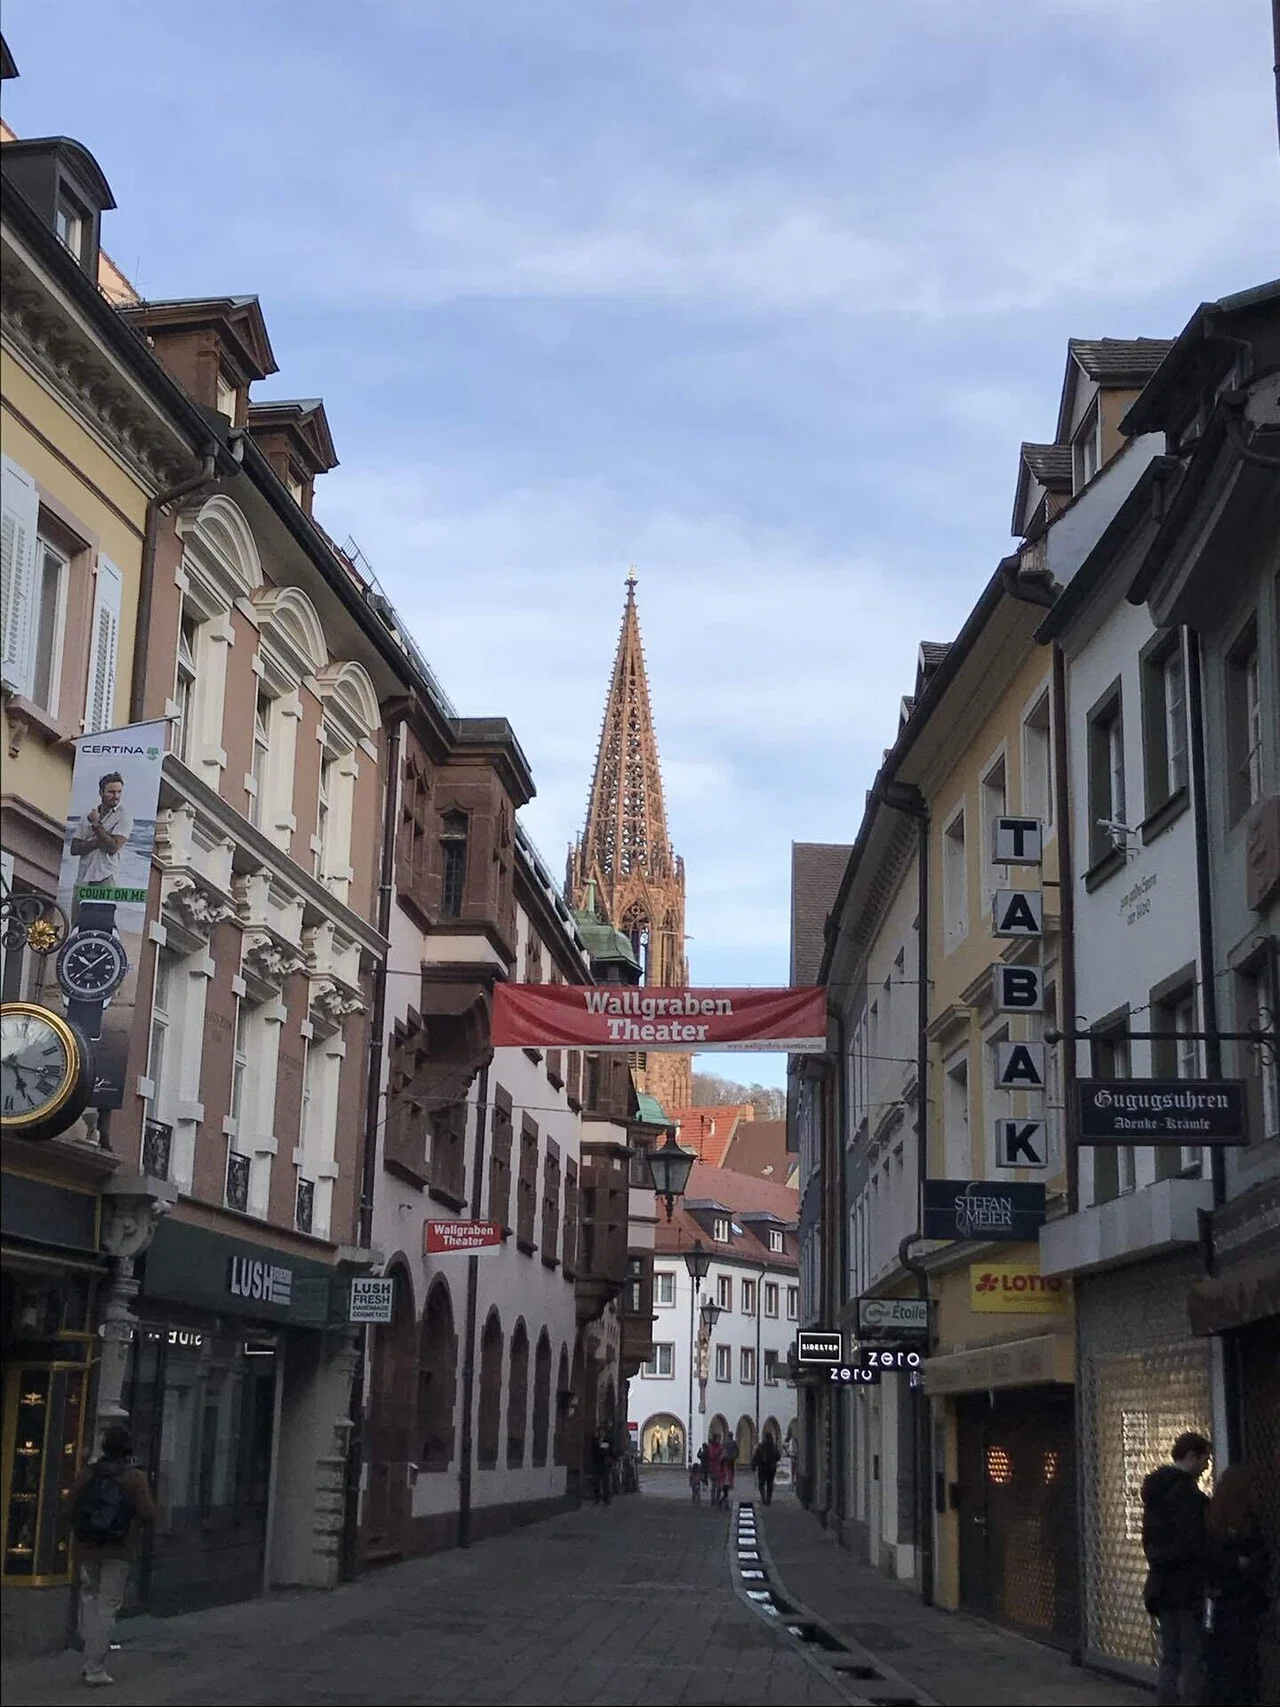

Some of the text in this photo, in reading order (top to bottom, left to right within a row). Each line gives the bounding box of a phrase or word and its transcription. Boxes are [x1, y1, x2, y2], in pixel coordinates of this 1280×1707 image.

[81, 745, 144, 755] CERTINA
[80, 888, 147, 901] COUNT ON ME
[999, 819, 1042, 1163] TABAK
[583, 991, 733, 1021] Wallgraben
[607, 1018, 709, 1041] Theater
[955, 1195, 1011, 1211] STEFAN
[966, 1210, 1012, 1225] MEIER
[434, 1224, 494, 1237] Wallgraben
[443, 1235, 484, 1246] Theater
[231, 1256, 274, 1301] LUSH
[1002, 1274, 1063, 1292] LOTTO
[354, 1283, 391, 1294] LUSH
[353, 1294, 390, 1304] FRESH
[802, 1344, 838, 1352] SIDESTEP
[868, 1352, 920, 1366] zero
[830, 1368, 872, 1380] zero
